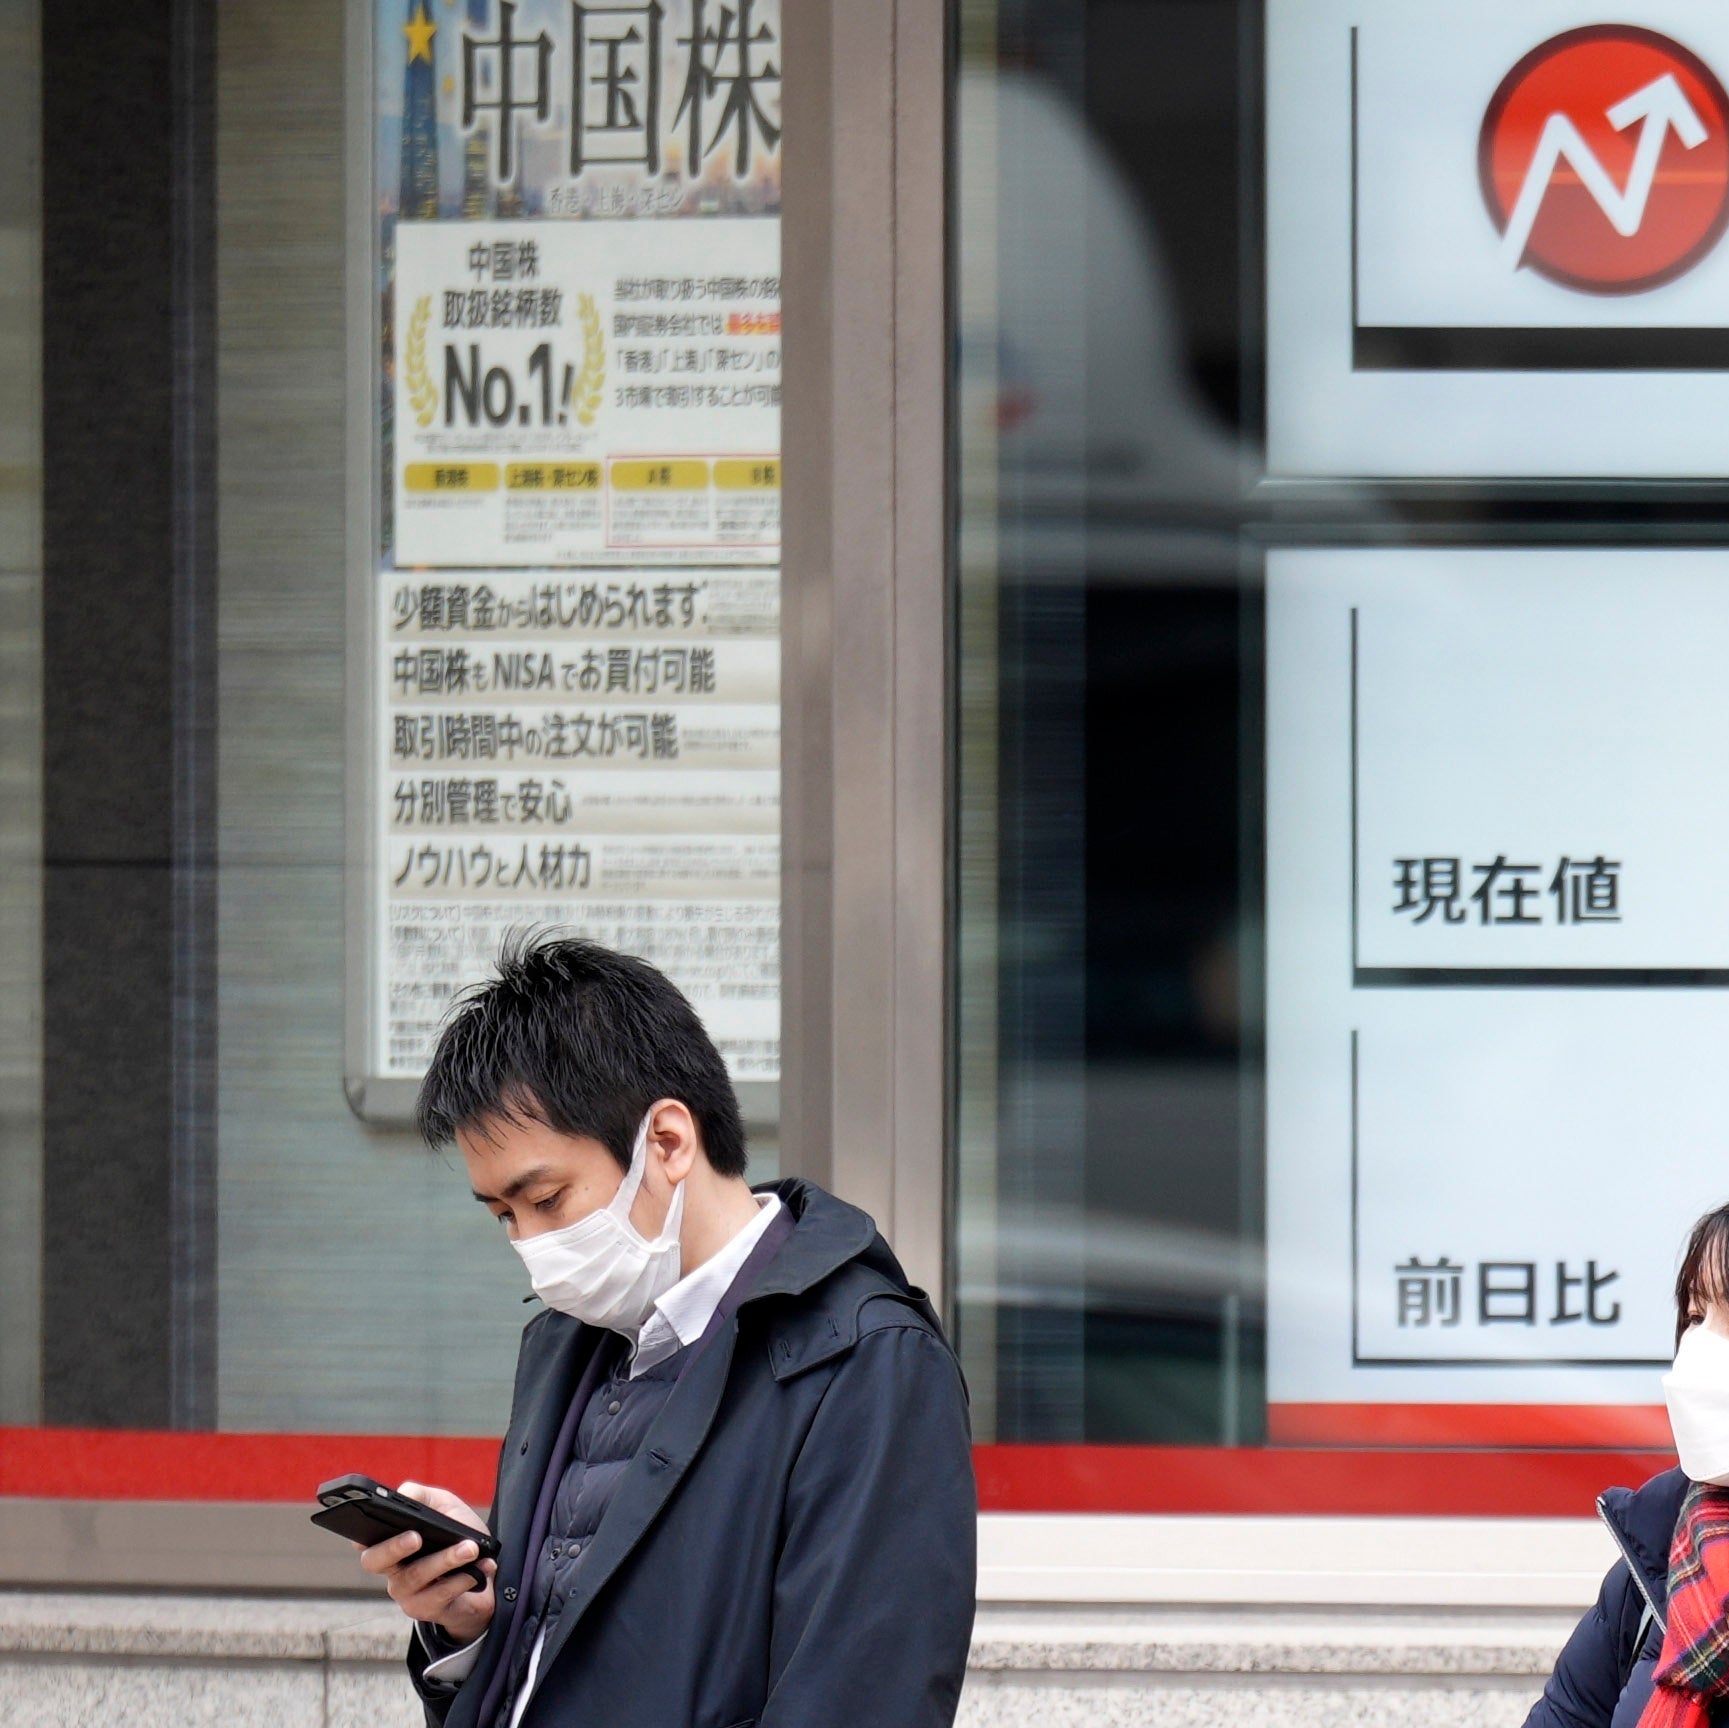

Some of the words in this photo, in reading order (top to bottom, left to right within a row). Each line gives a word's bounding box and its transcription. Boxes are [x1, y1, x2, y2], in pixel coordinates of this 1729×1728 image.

[461, 0, 781, 180] 中国株
[469, 240, 540, 281] 中国株
[443, 289, 564, 328] 取扱銘柄数
[394, 713, 679, 760] 取引時間中の注文が可能
[394, 780, 573, 826] 分別管理で安心
[394, 845, 591, 890] ノウハウと人材力
[1393, 854, 1622, 926] 現在値
[1395, 1254, 1622, 1329] 前日比
